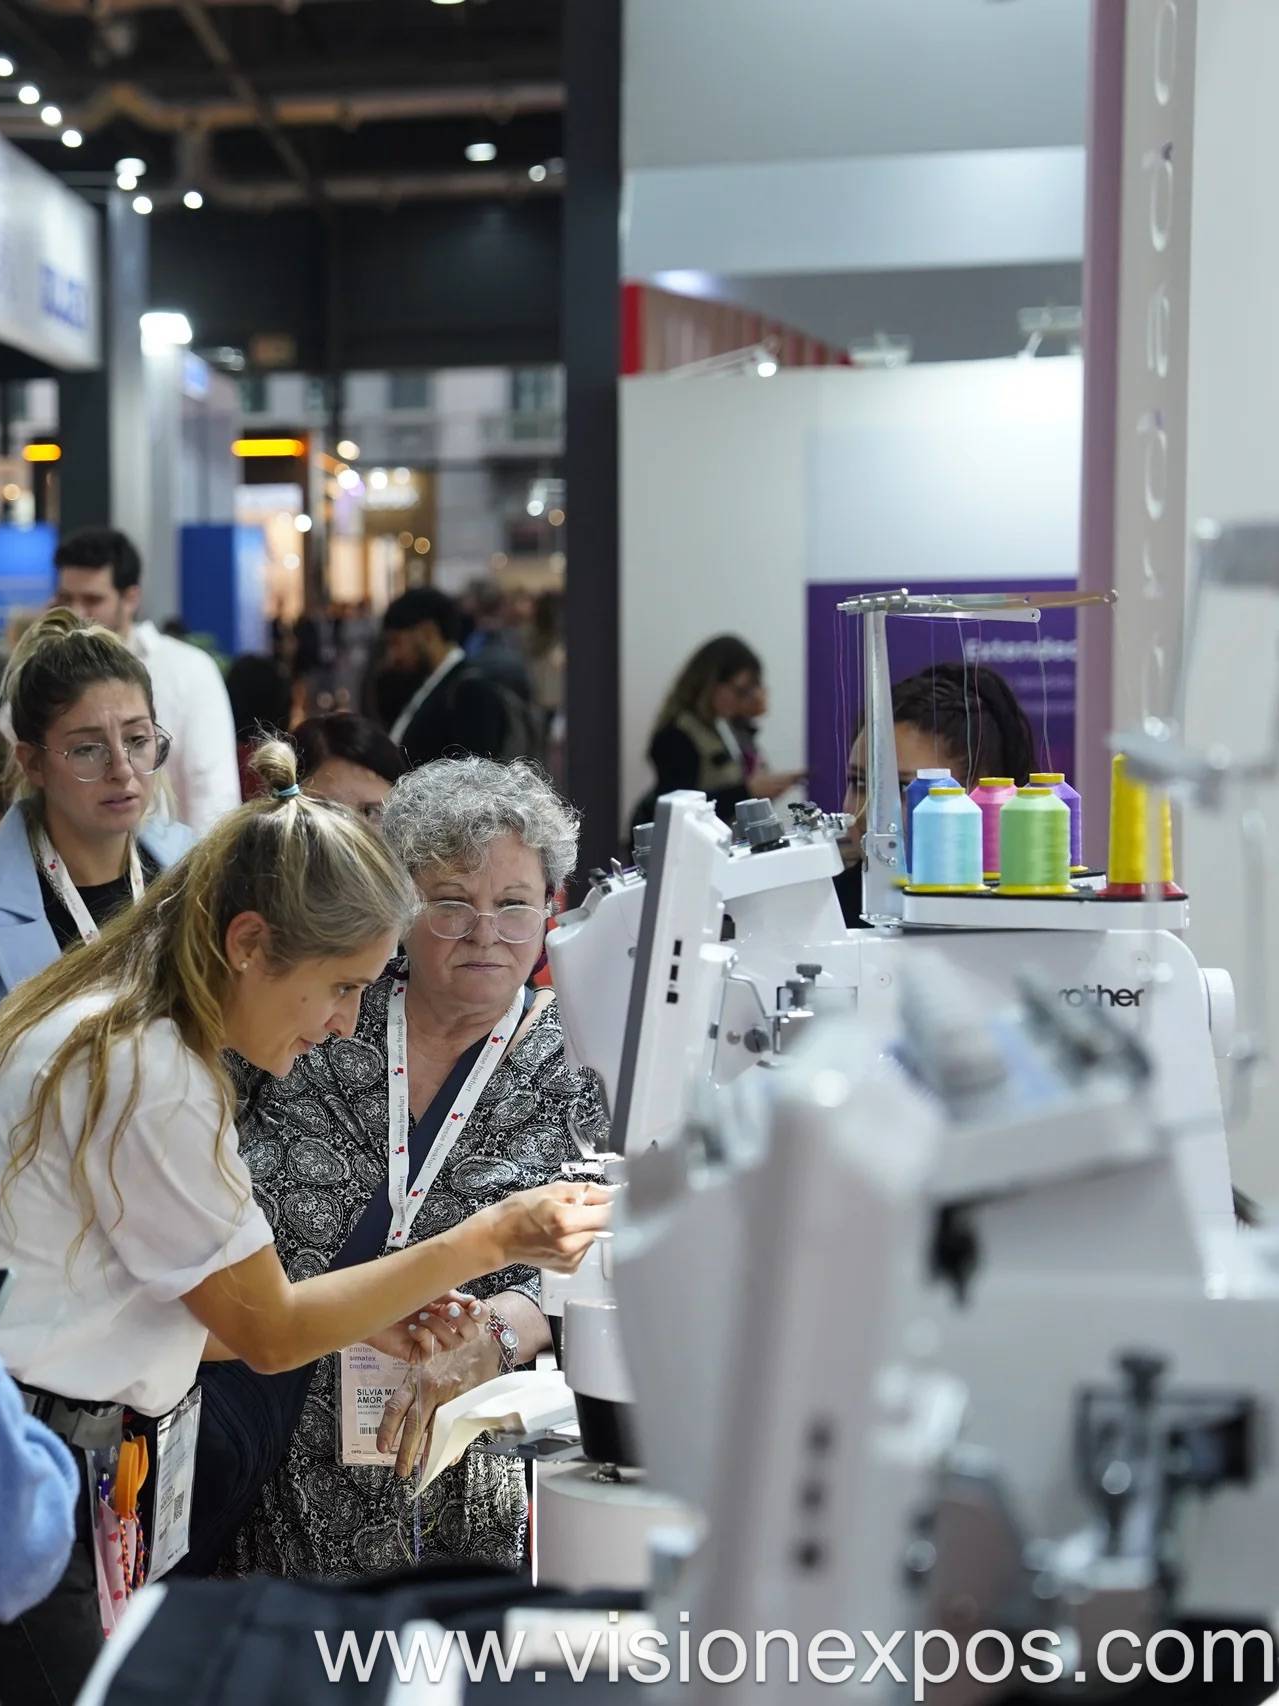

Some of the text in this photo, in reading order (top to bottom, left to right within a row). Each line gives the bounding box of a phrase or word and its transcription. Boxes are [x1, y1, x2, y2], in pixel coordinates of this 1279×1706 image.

[1059, 984, 1144, 1007] rother
[397, 1095, 405, 1143] messe frankfurt
[356, 1388, 383, 1396] SILVIA
[357, 1396, 383, 1404] AMOR
